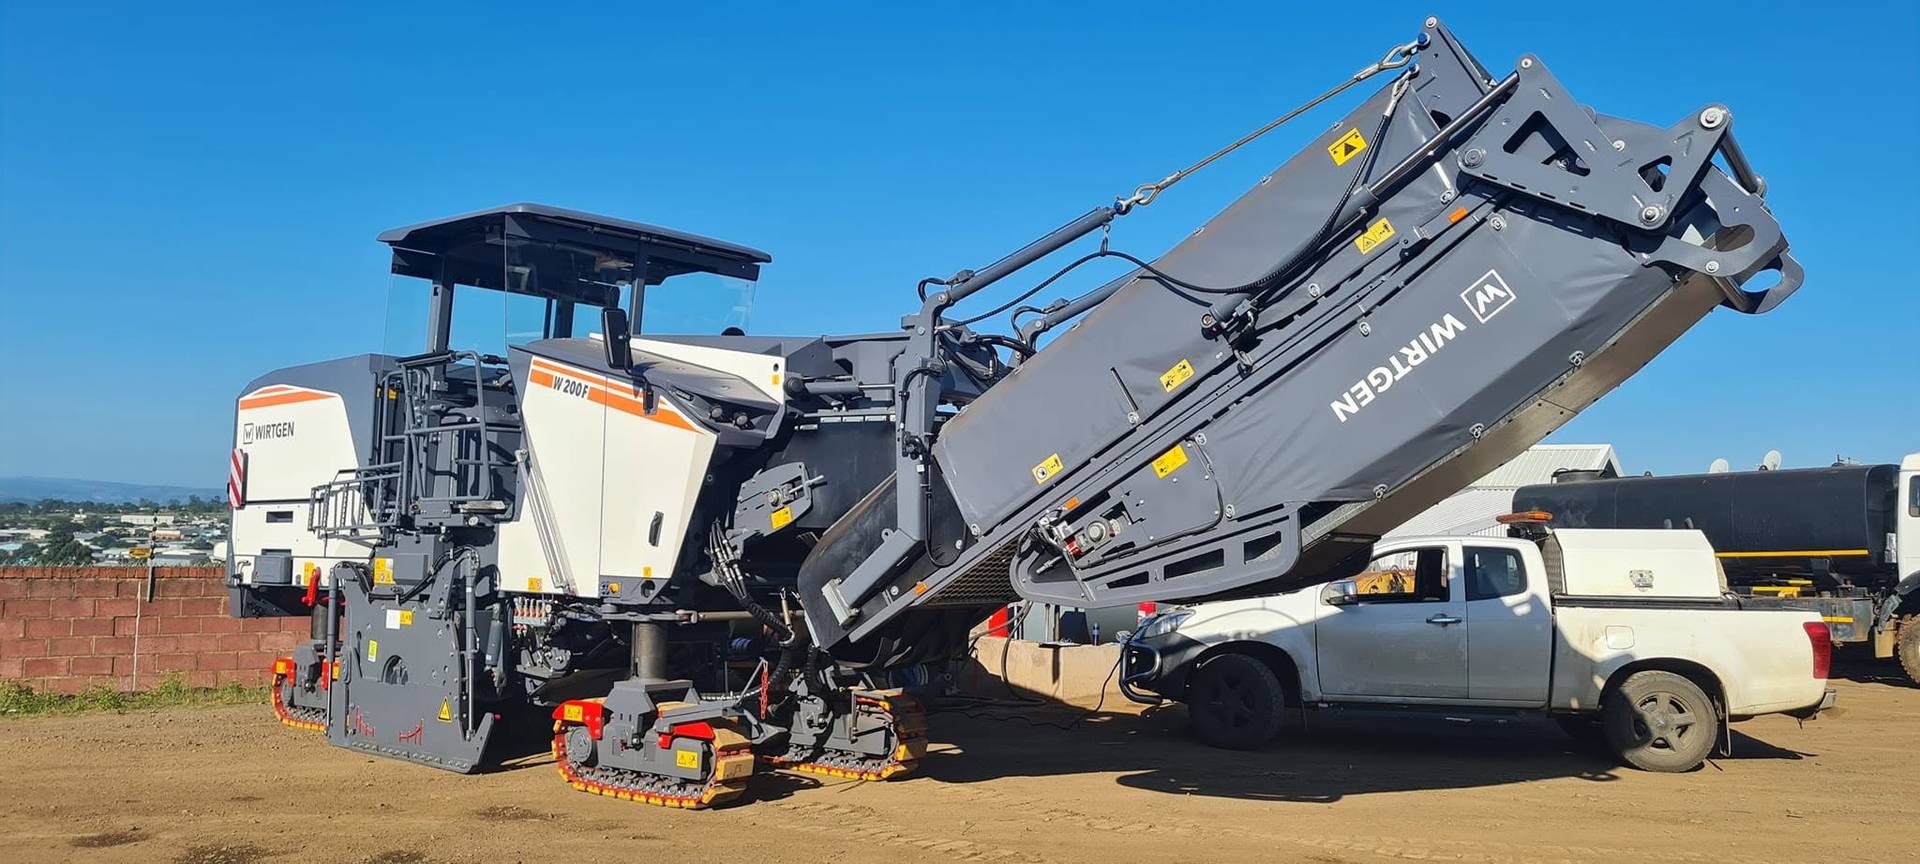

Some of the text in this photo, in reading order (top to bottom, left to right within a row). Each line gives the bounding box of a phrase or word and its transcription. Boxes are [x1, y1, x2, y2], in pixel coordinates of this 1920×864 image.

[1330, 312, 1467, 423] WIRTGEN
[553, 375, 588, 398] W 200F
[255, 421, 295, 440] WIRTGEN
